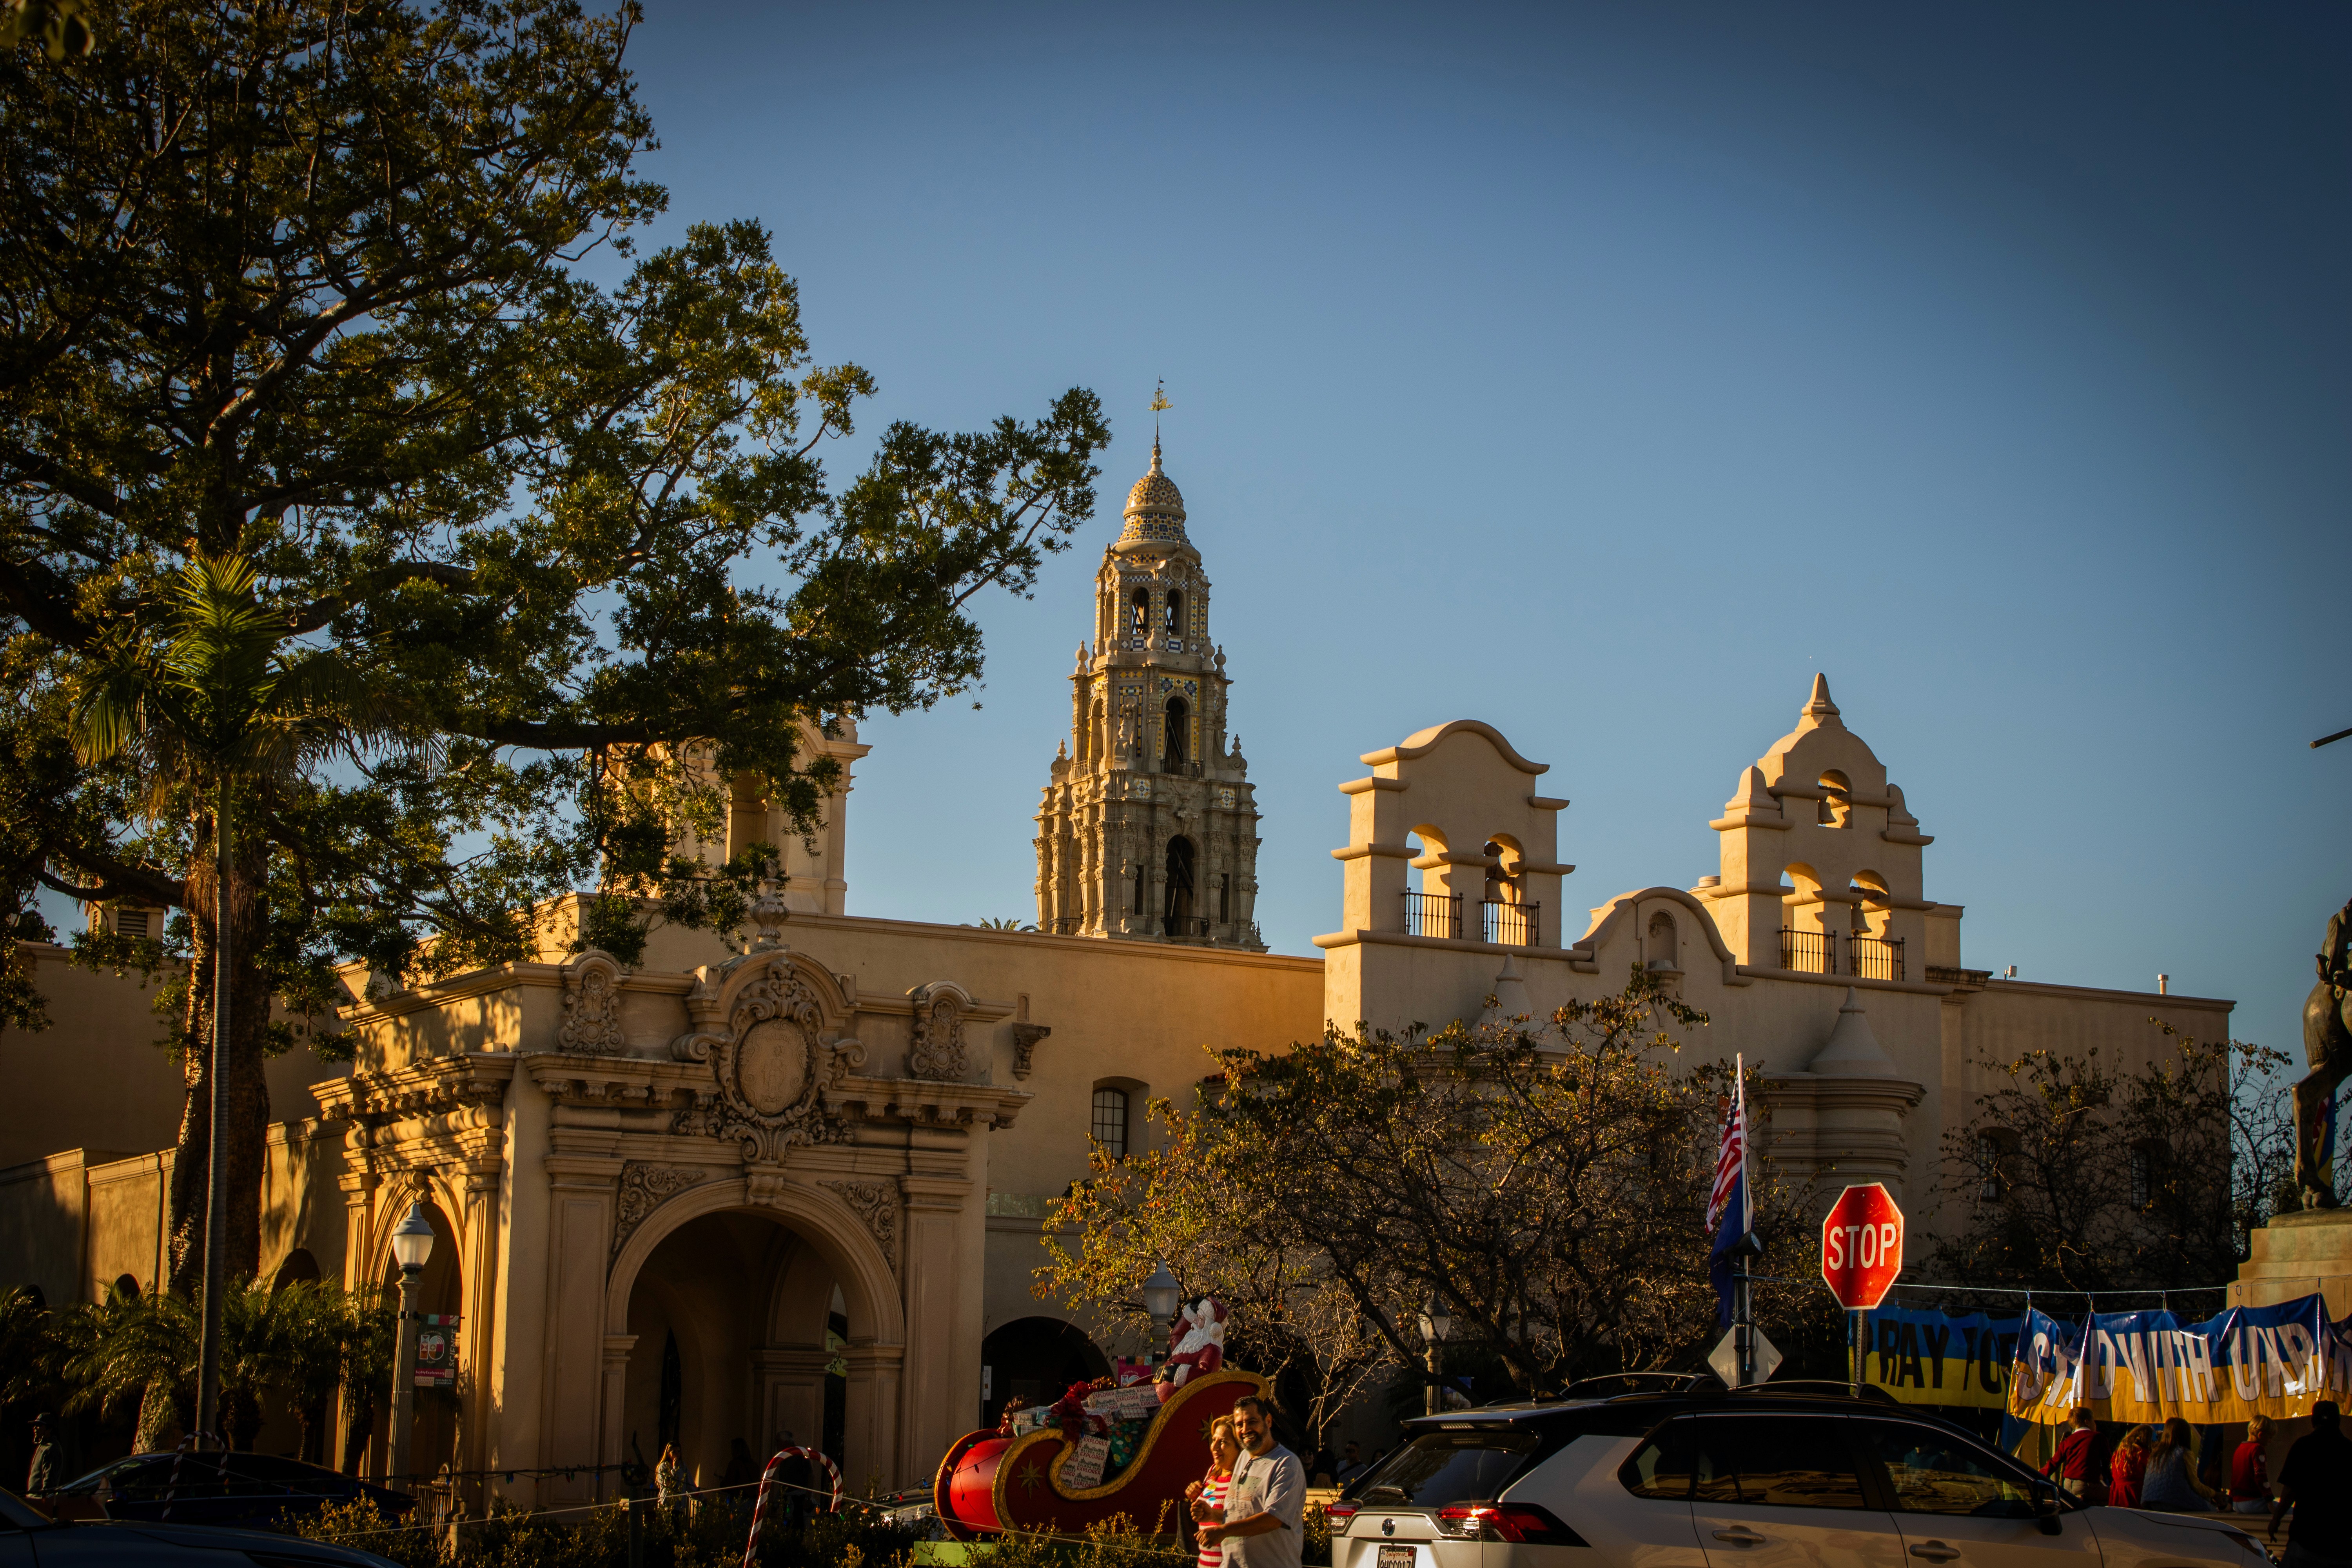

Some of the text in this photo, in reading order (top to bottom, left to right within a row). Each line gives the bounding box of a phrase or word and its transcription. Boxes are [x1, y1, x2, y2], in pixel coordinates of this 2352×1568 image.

[1828, 1223, 1896, 1270] STOP
[2017, 1330, 2116, 1408] STD
[2115, 1330, 2220, 1403] WITH
[1083, 1437, 1107, 1446] EXPLORER
[1080, 1452, 1104, 1461] EXPLORER
[1076, 1466, 1101, 1475] EXPLORER
